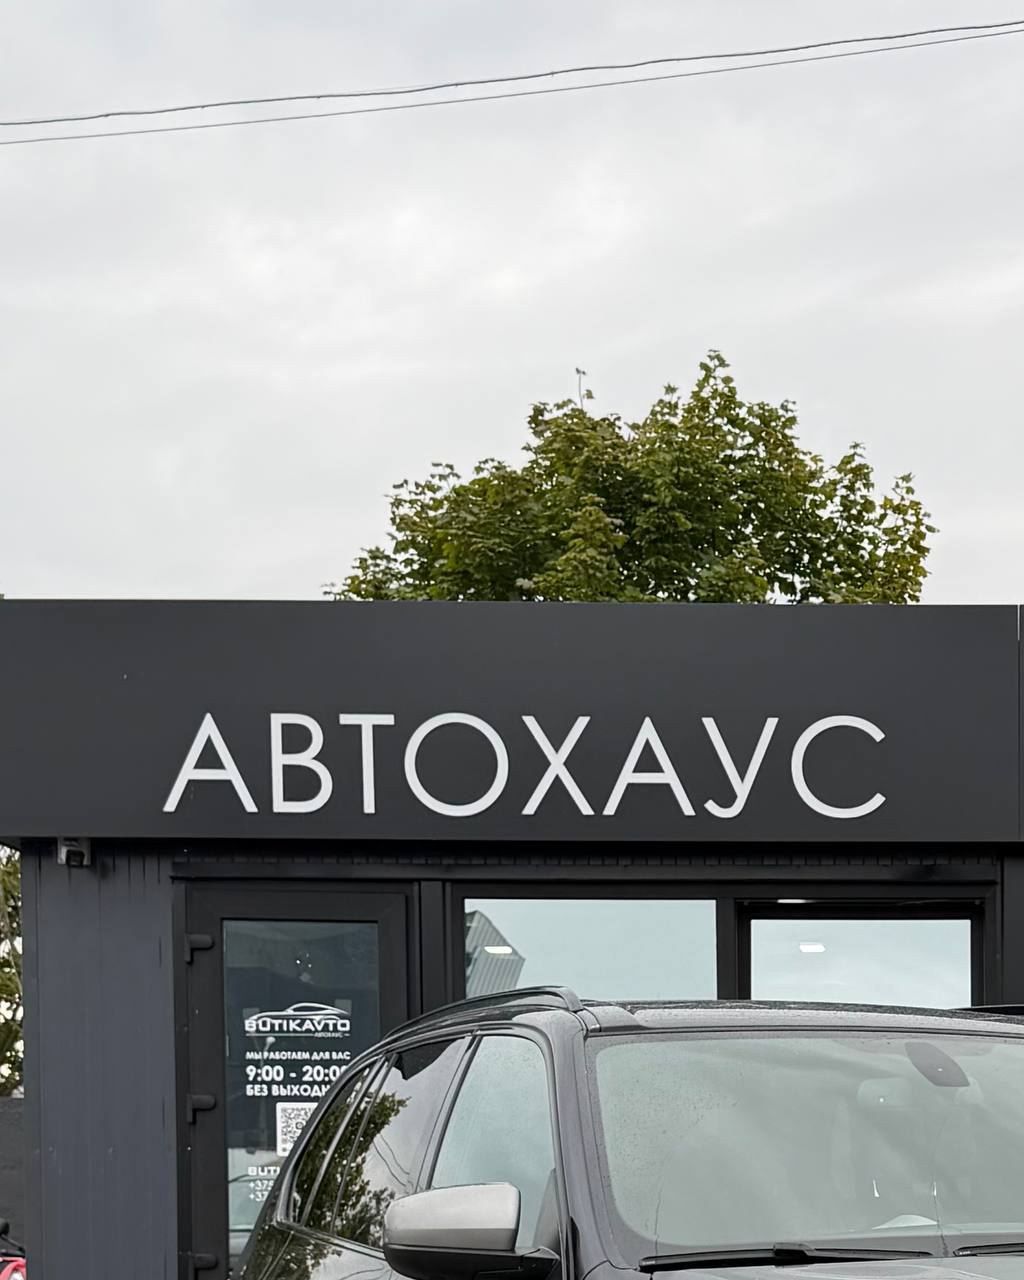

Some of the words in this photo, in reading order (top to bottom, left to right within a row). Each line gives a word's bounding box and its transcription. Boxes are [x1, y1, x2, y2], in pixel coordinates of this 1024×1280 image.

[162, 712, 886, 819] АВТОХАУС
[245, 1019, 350, 1031] BUTIKAVTO
[246, 1051, 261, 1060] МЫ
[263, 1051, 310, 1060] РАБОТАЕМ
[311, 1051, 330, 1061] ДЛЯ
[332, 1051, 351, 1060] ВАС
[246, 1065, 284, 1081] 9:00
[246, 1084, 268, 1096] БЕЗ
